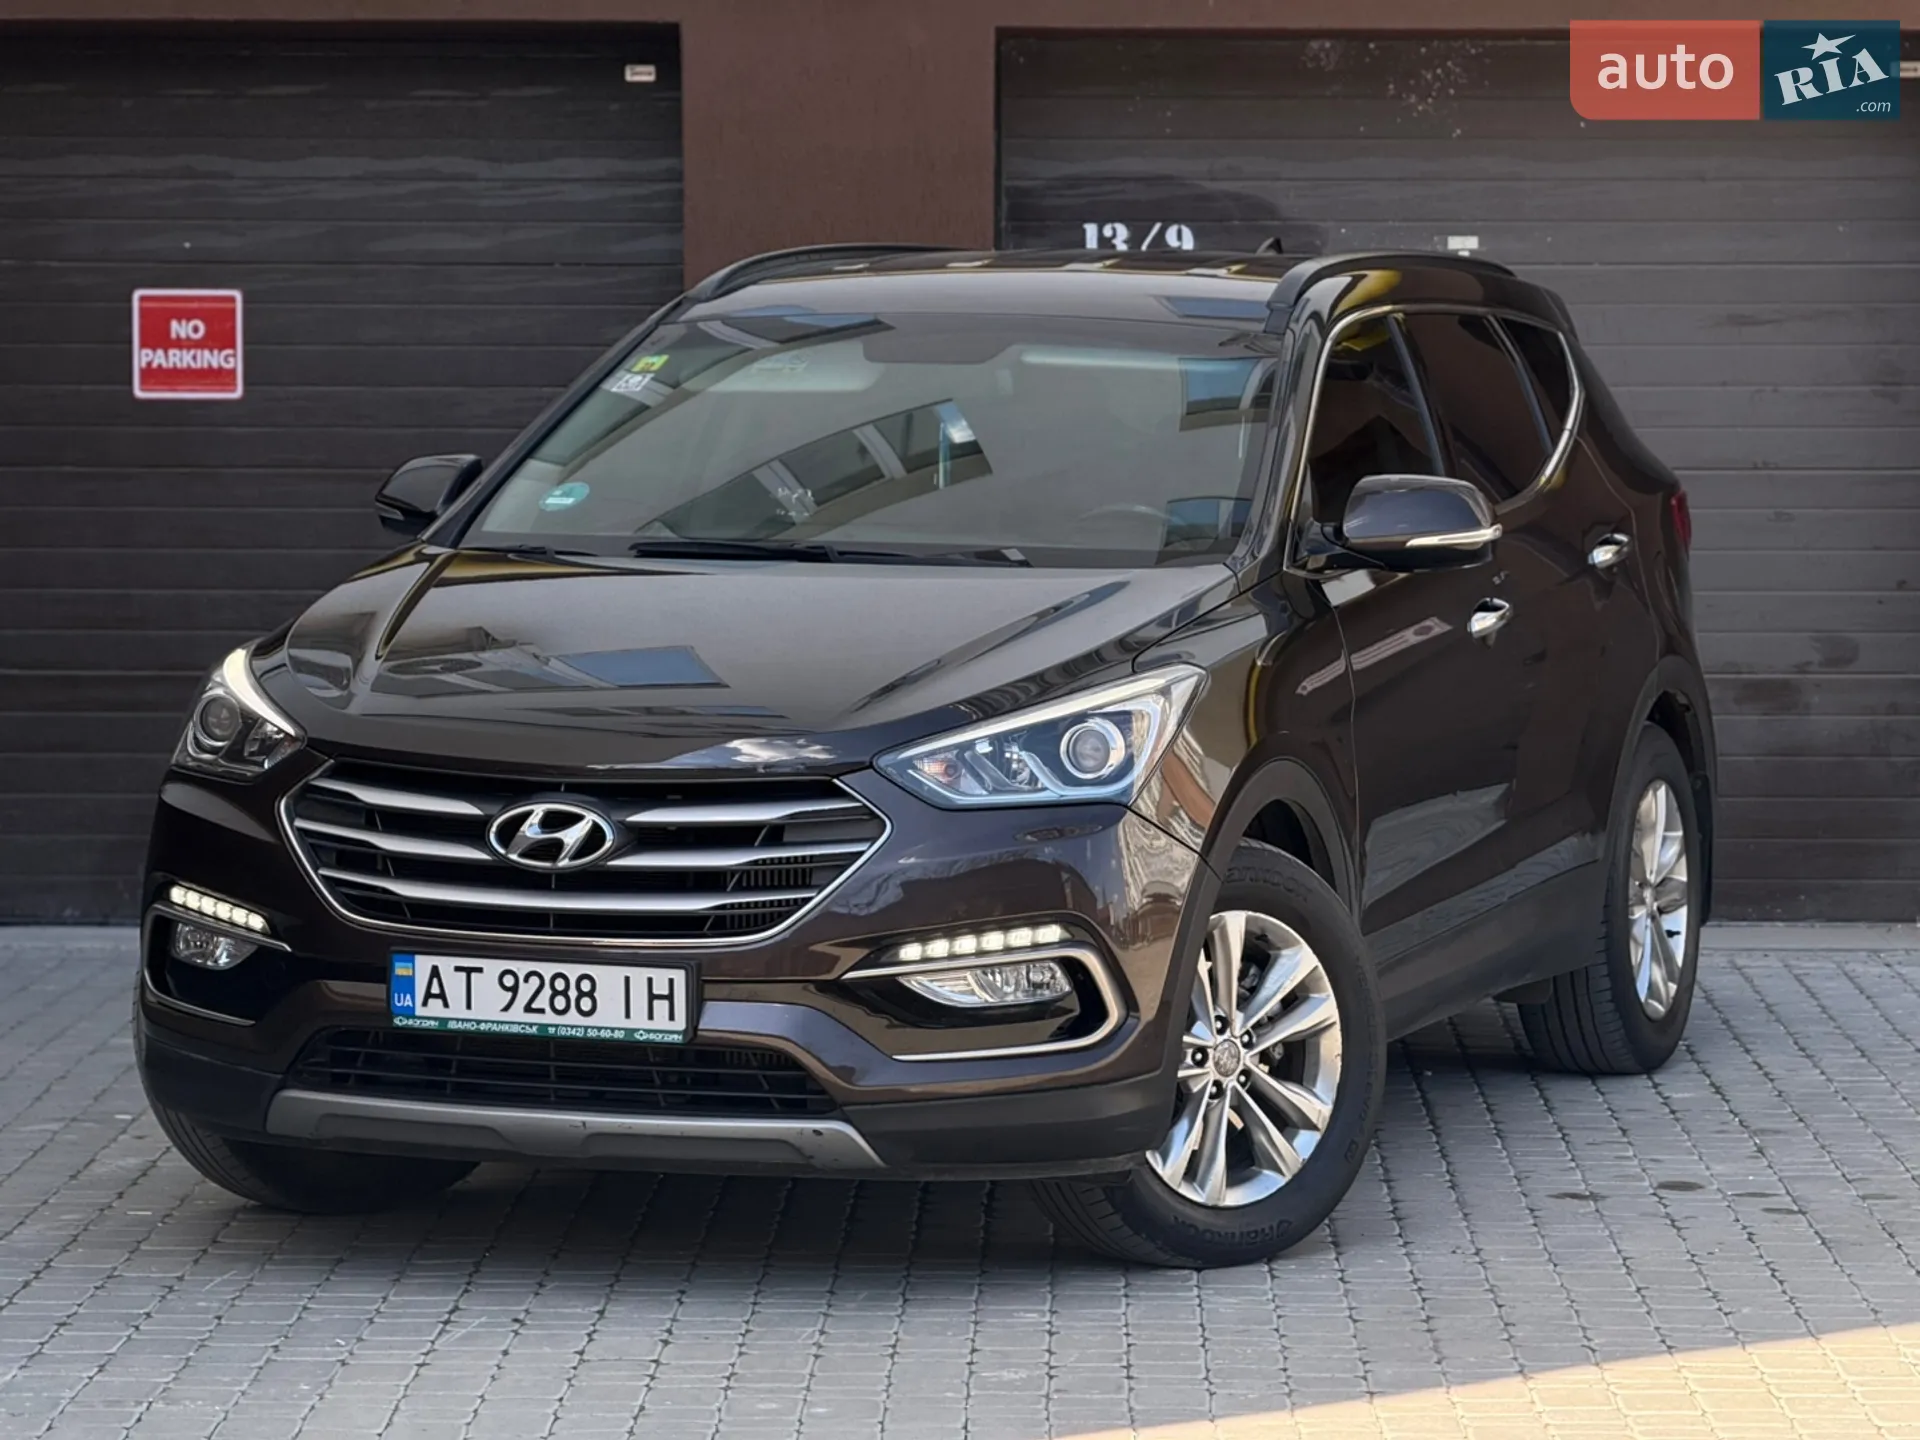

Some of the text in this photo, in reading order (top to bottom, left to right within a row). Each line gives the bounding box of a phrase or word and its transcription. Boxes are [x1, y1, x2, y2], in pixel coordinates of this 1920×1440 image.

[170, 318, 206, 340] NO
[140, 348, 236, 369] PARKING
[394, 993, 414, 1008] UA
[421, 964, 676, 1022] AT 9288 IH
[557, 1026, 585, 1037] (0342)
[587, 1028, 625, 1039] 50-60-80
